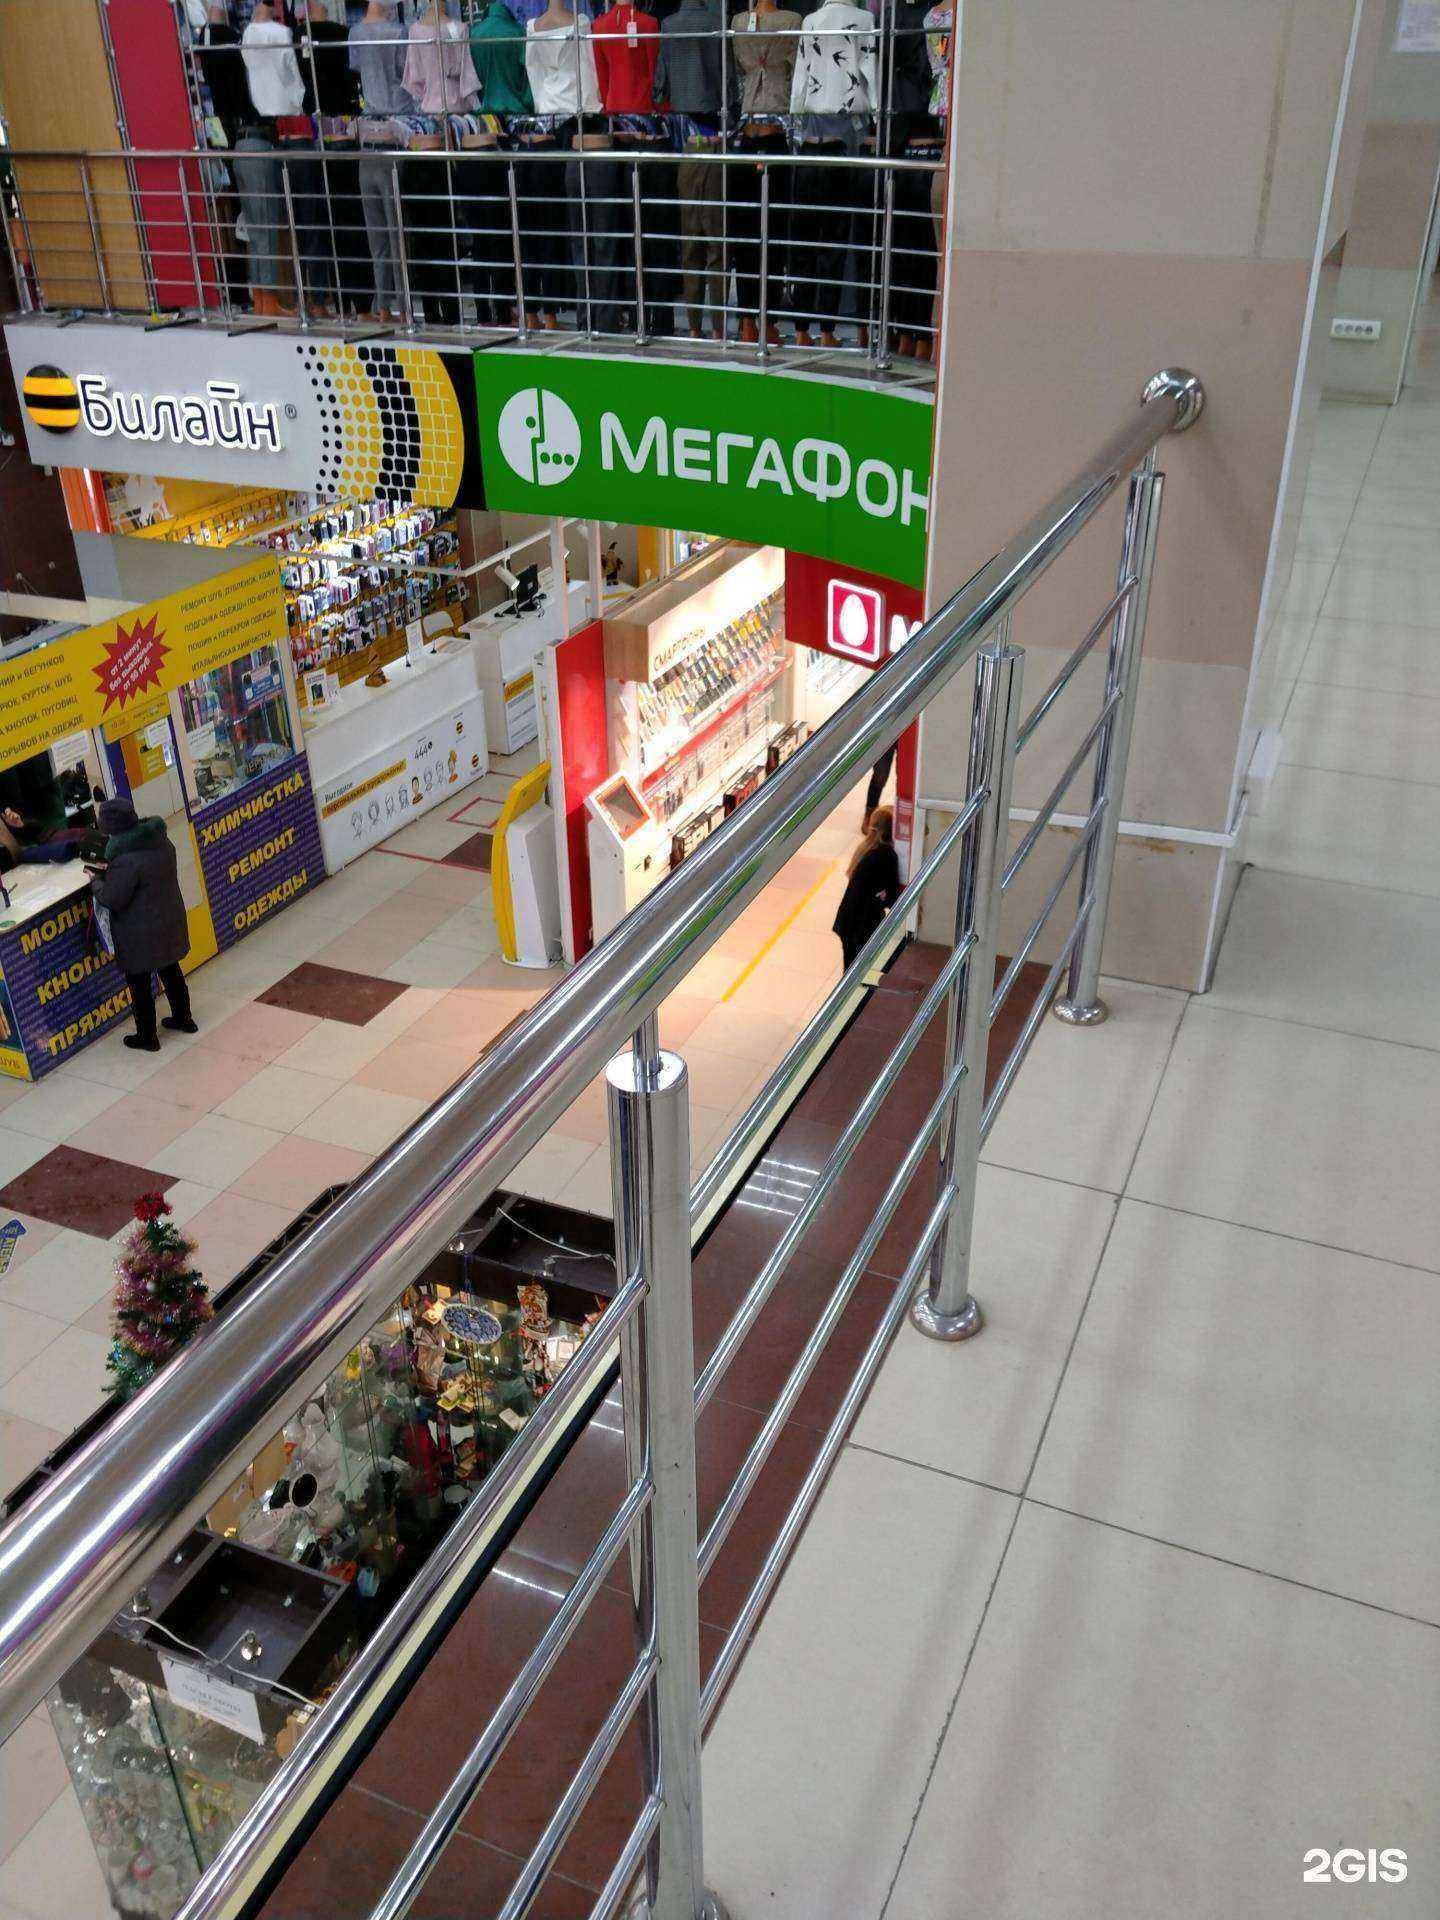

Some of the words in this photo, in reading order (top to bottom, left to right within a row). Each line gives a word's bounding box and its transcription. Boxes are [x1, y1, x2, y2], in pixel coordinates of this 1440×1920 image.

[180, 597, 207, 615] РЕМОНТ
[200, 771, 306, 848] ХИМЧИСТКА
[228, 826, 296, 885] РЕМОНТ
[233, 866, 310, 931] ОДЕЖДЫ
